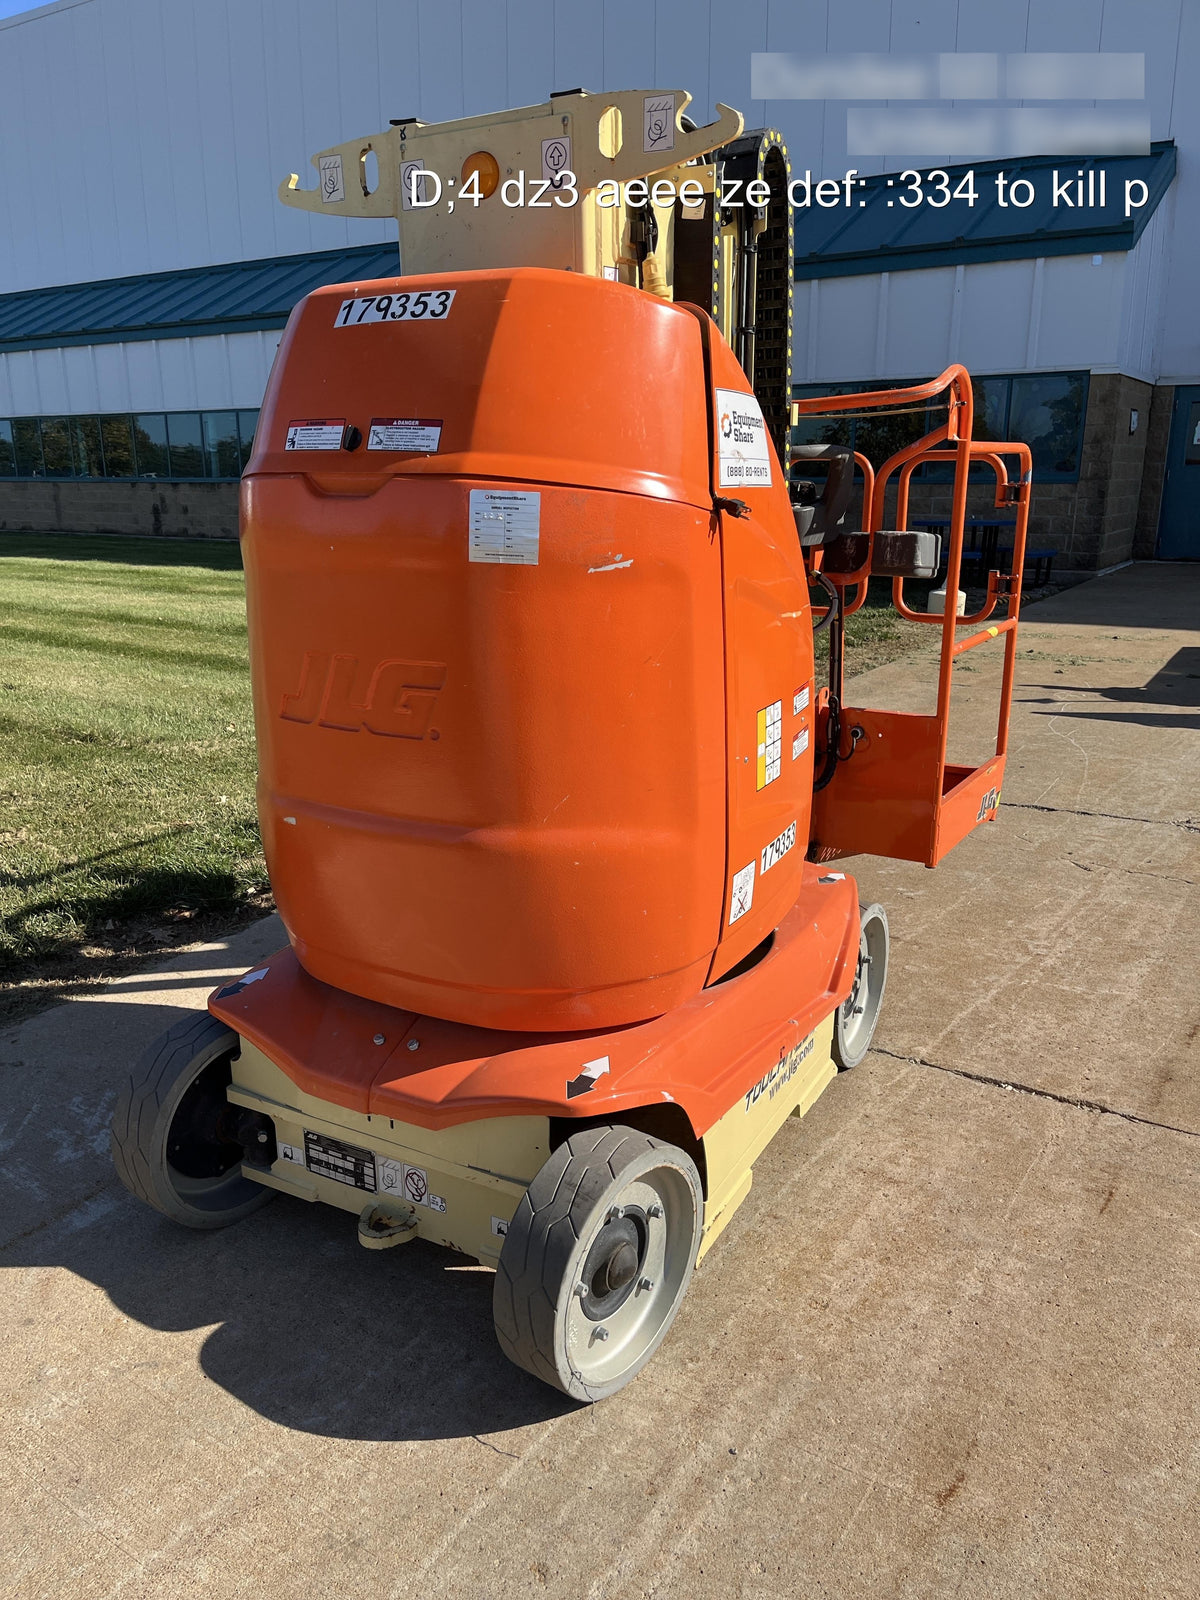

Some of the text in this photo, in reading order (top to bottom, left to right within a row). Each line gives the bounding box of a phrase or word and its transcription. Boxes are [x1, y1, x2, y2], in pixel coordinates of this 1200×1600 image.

[341, 290, 451, 326] 179353
[733, 428, 754, 443] Share
[727, 465, 744, 478] (888)
[762, 822, 796, 872] 179353
